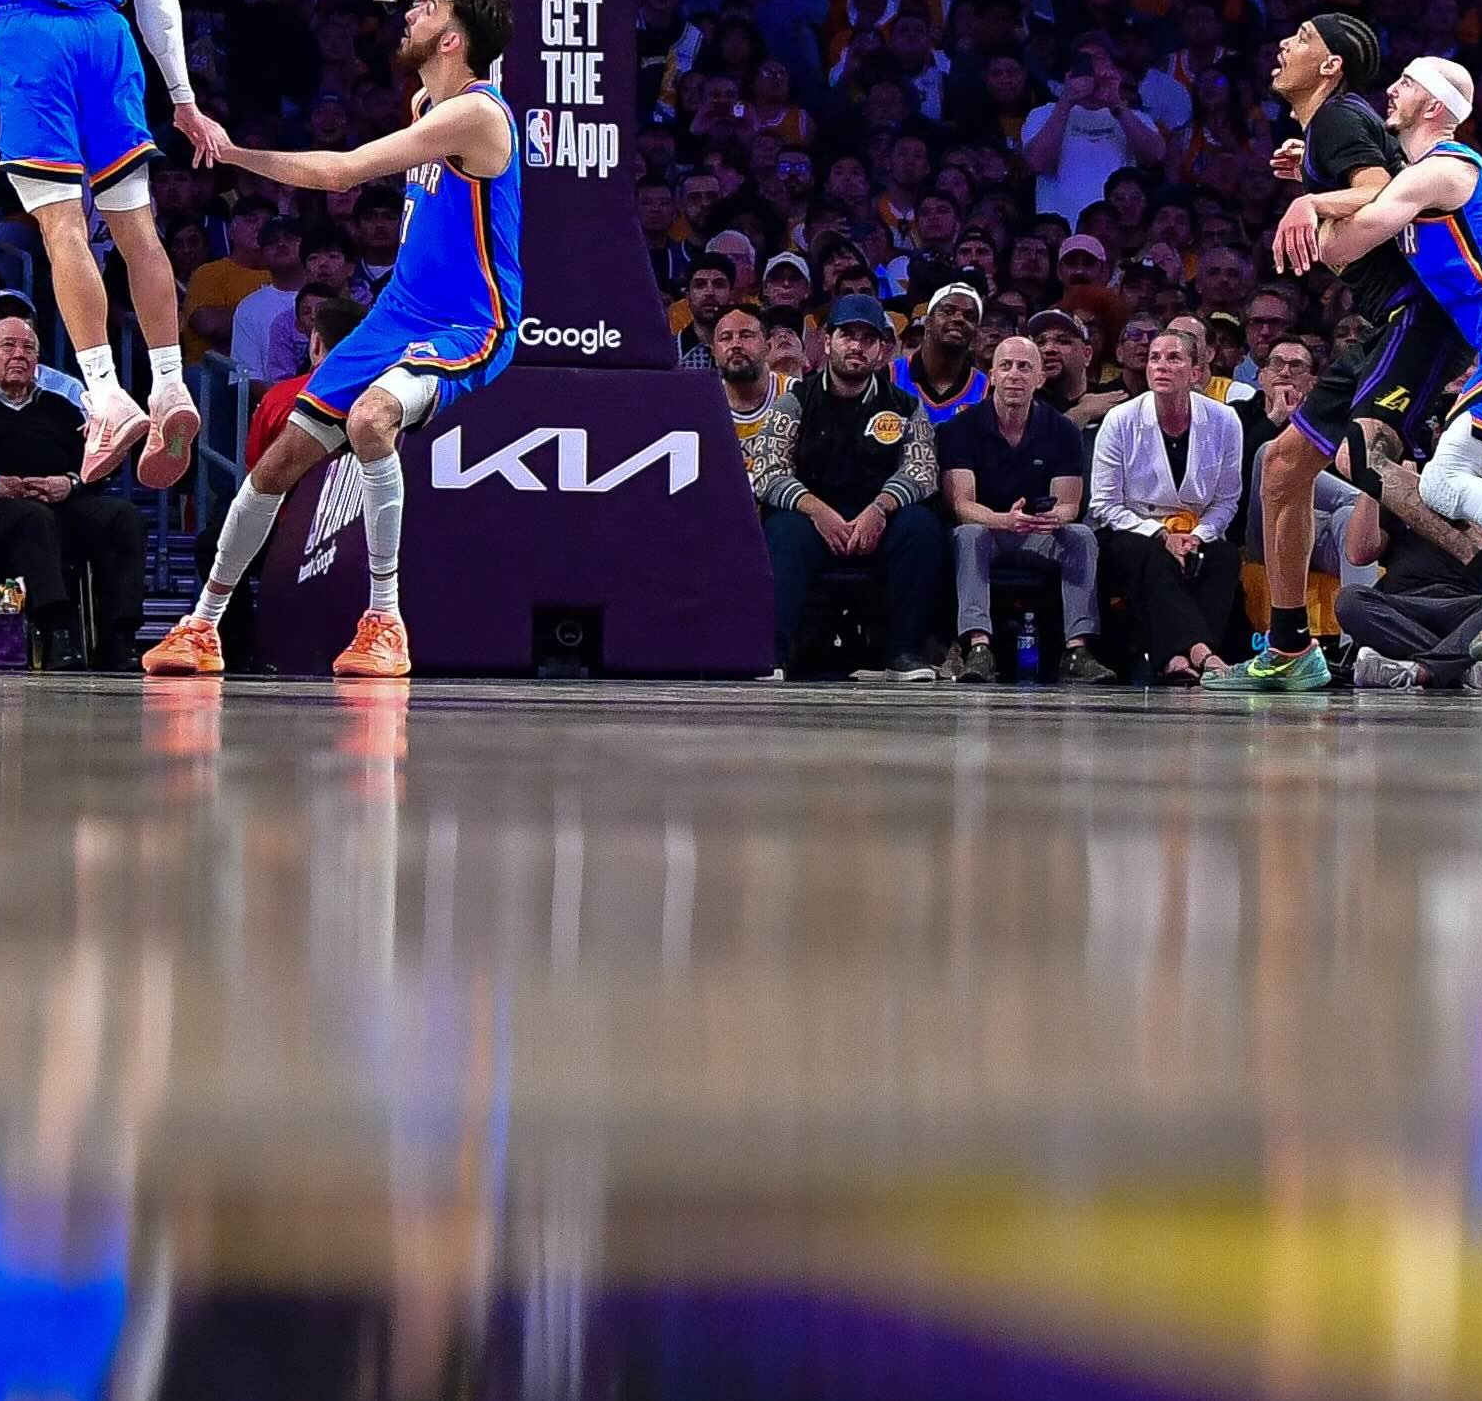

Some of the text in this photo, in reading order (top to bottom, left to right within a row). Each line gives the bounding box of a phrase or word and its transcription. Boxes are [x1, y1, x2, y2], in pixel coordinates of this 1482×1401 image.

[539, 51, 605, 105] THE
[555, 110, 620, 178] App
[517, 317, 623, 355] Google
[431, 425, 700, 496] KIA
